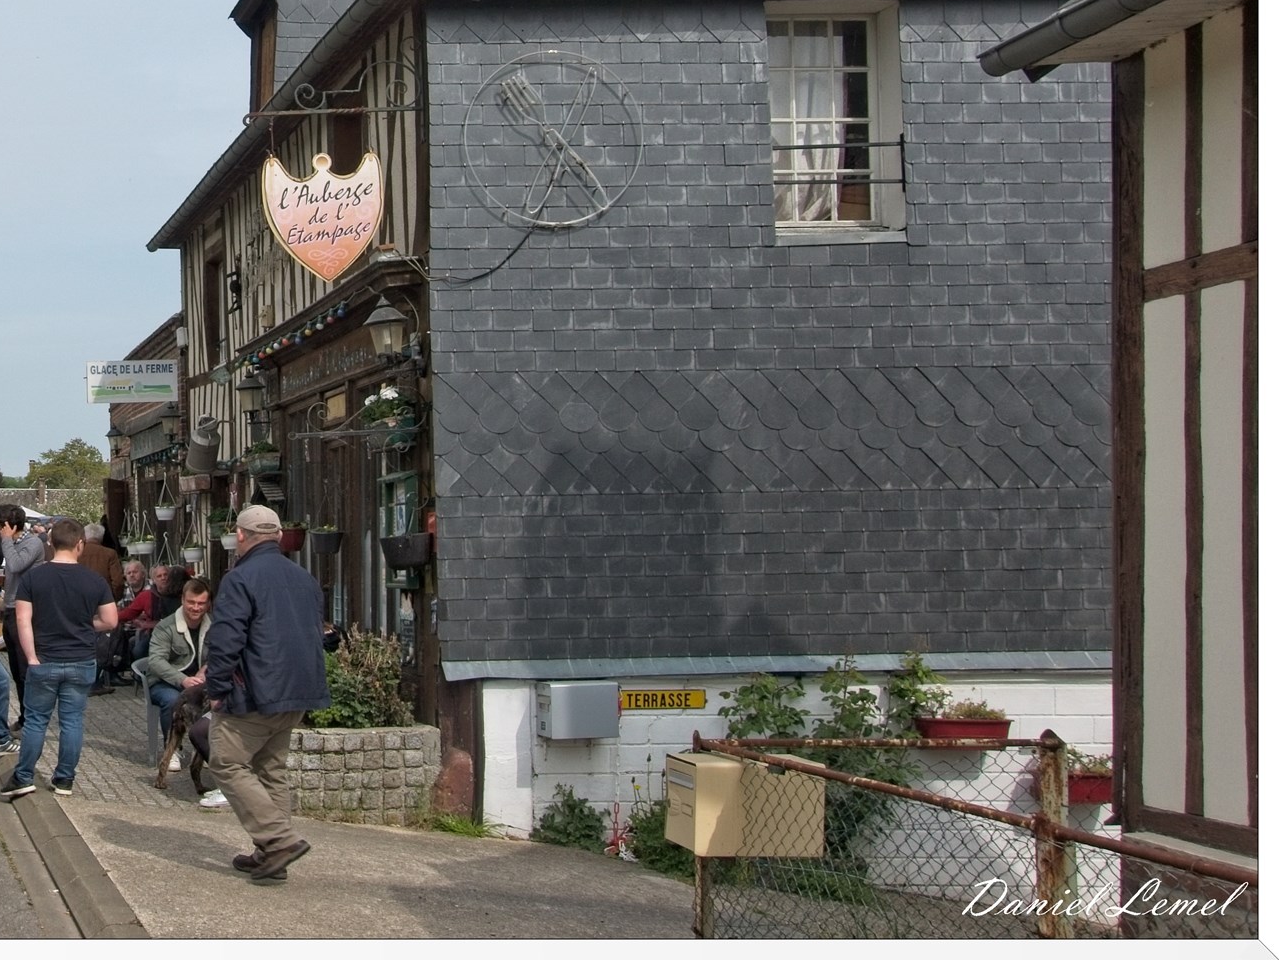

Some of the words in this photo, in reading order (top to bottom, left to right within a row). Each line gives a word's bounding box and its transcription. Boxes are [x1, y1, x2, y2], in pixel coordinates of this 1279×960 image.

[278, 180, 373, 210] l'Auberge
[308, 206, 328, 225] de
[335, 203, 350, 221] l'
[287, 222, 371, 245] Étampage
[90, 364, 118, 375] GLACE
[119, 364, 131, 374] DE
[132, 364, 144, 374] LA
[145, 363, 174, 374] FERME
[626, 693, 692, 708] TERRASSE
